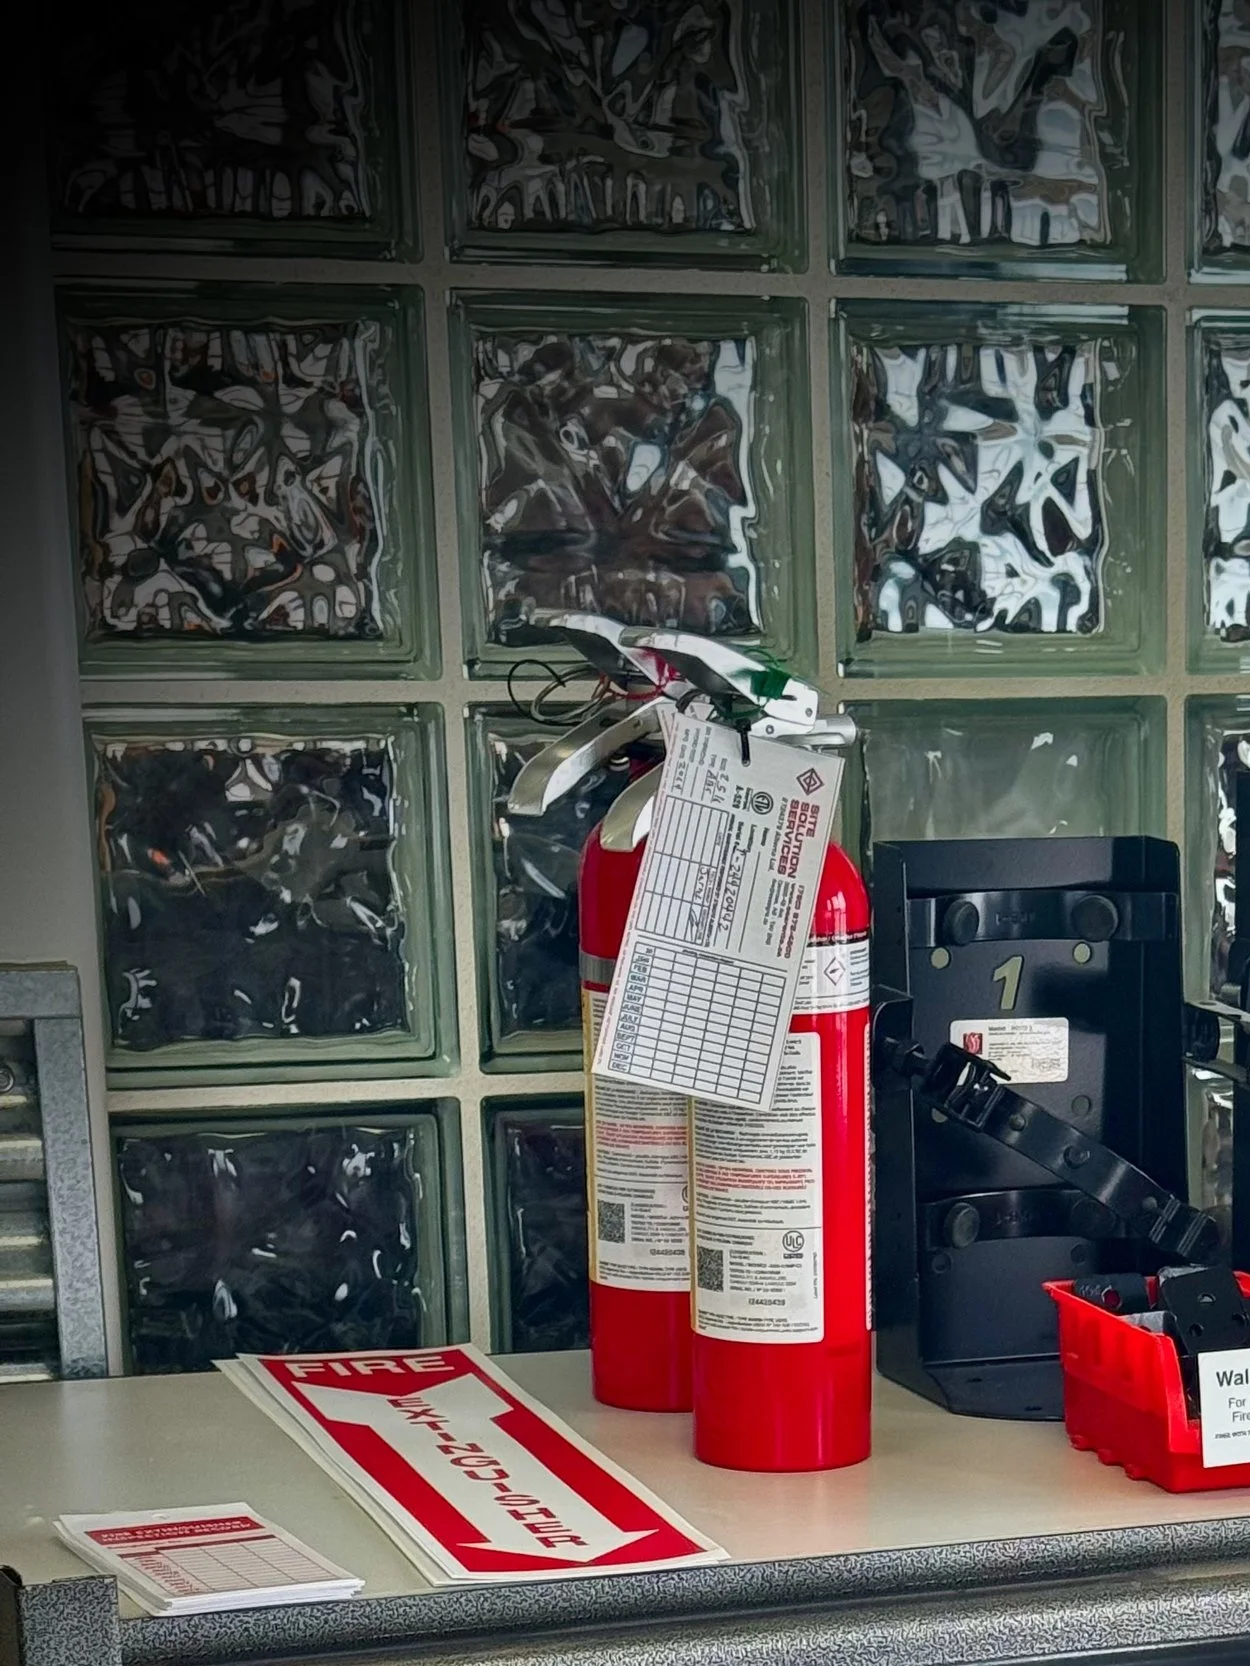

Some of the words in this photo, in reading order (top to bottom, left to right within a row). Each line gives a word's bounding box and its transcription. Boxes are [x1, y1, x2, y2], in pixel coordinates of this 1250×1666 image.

[777, 799, 799, 875] SERVICES
[787, 801, 810, 879] SOLUTION
[806, 804, 820, 838] SITE
[992, 955, 1024, 1010] 1
[284, 1354, 455, 1379] FIRE
[1228, 1397, 1246, 1409] For
[386, 1396, 589, 1549] EXTINGUISHER
